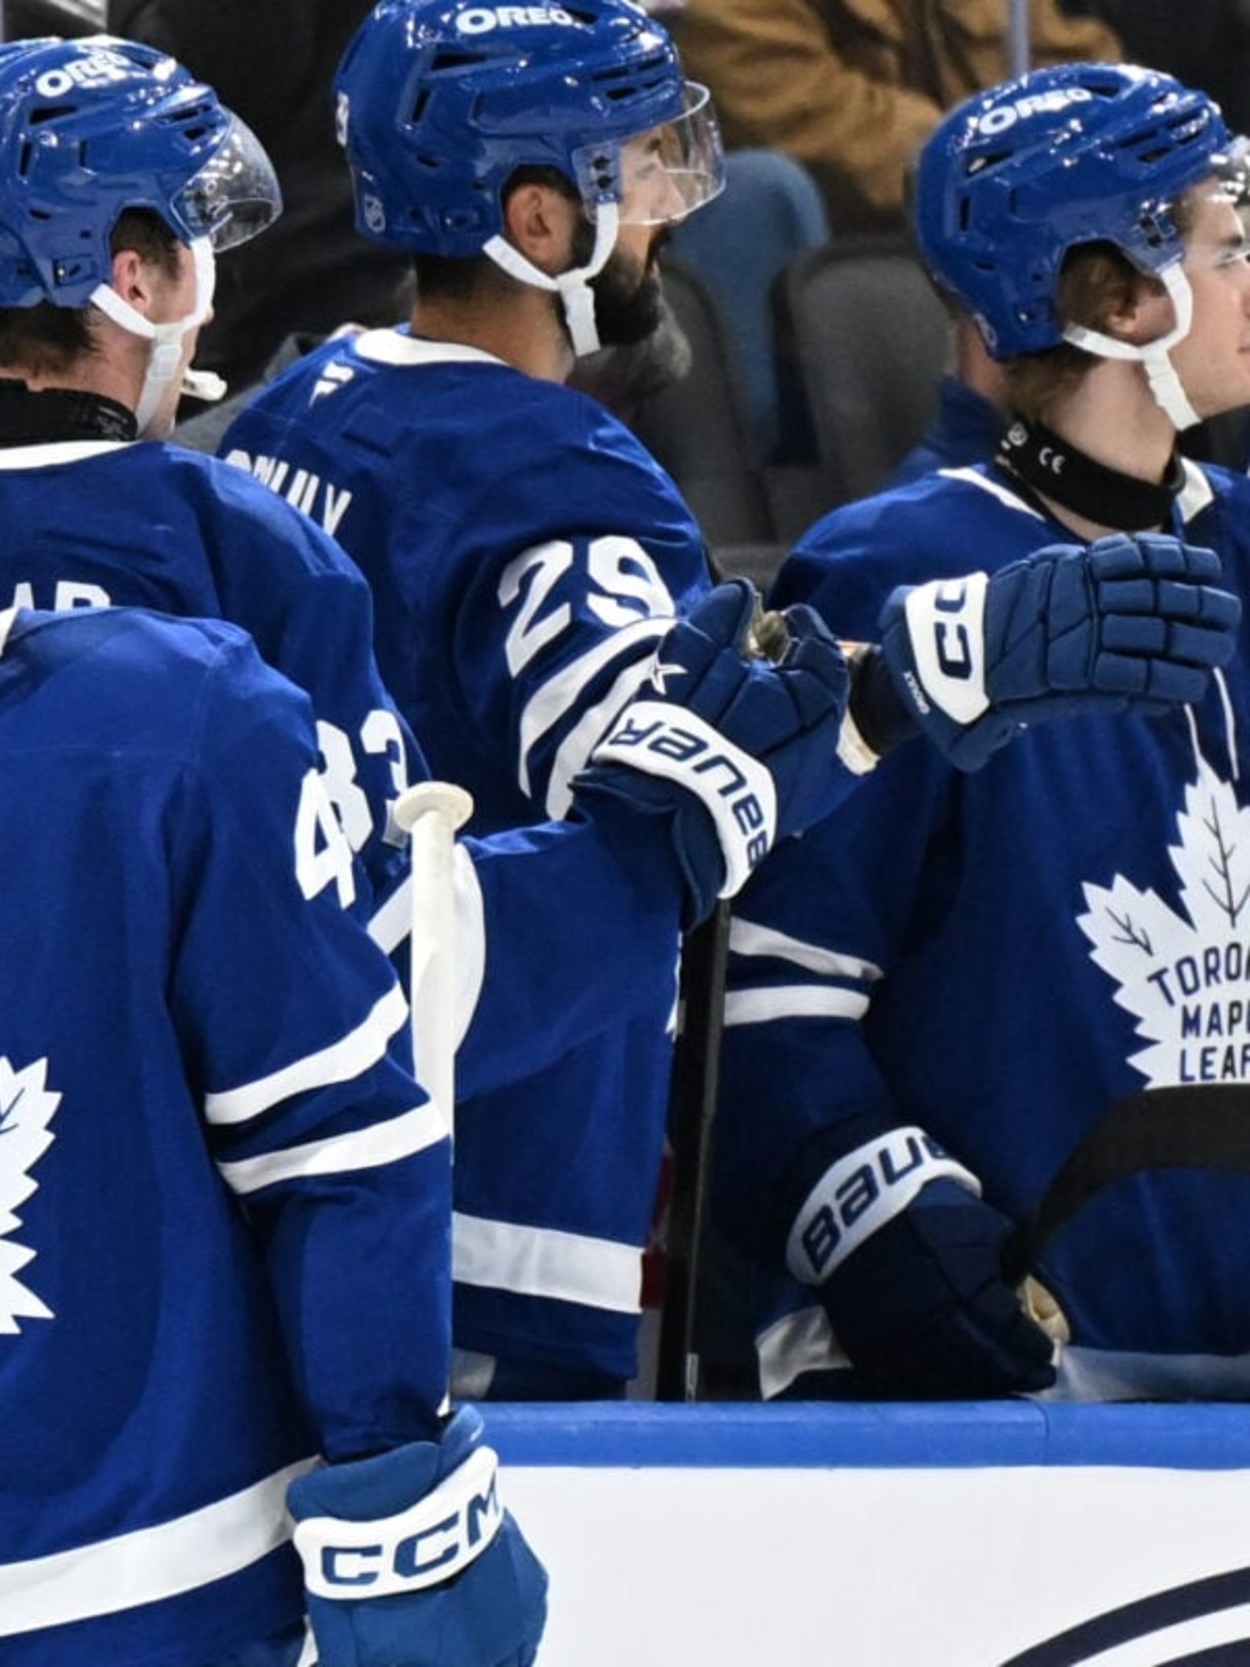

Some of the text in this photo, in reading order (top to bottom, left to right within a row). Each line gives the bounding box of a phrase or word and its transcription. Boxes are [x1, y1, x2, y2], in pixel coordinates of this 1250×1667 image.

[456, 6, 573, 34] OREO
[979, 87, 1093, 135] OREO
[497, 535, 676, 680] 29
[1146, 941, 1250, 1008] TORO
[1181, 1000, 1250, 1040] MAP
[321, 1471, 498, 1585] CCM
